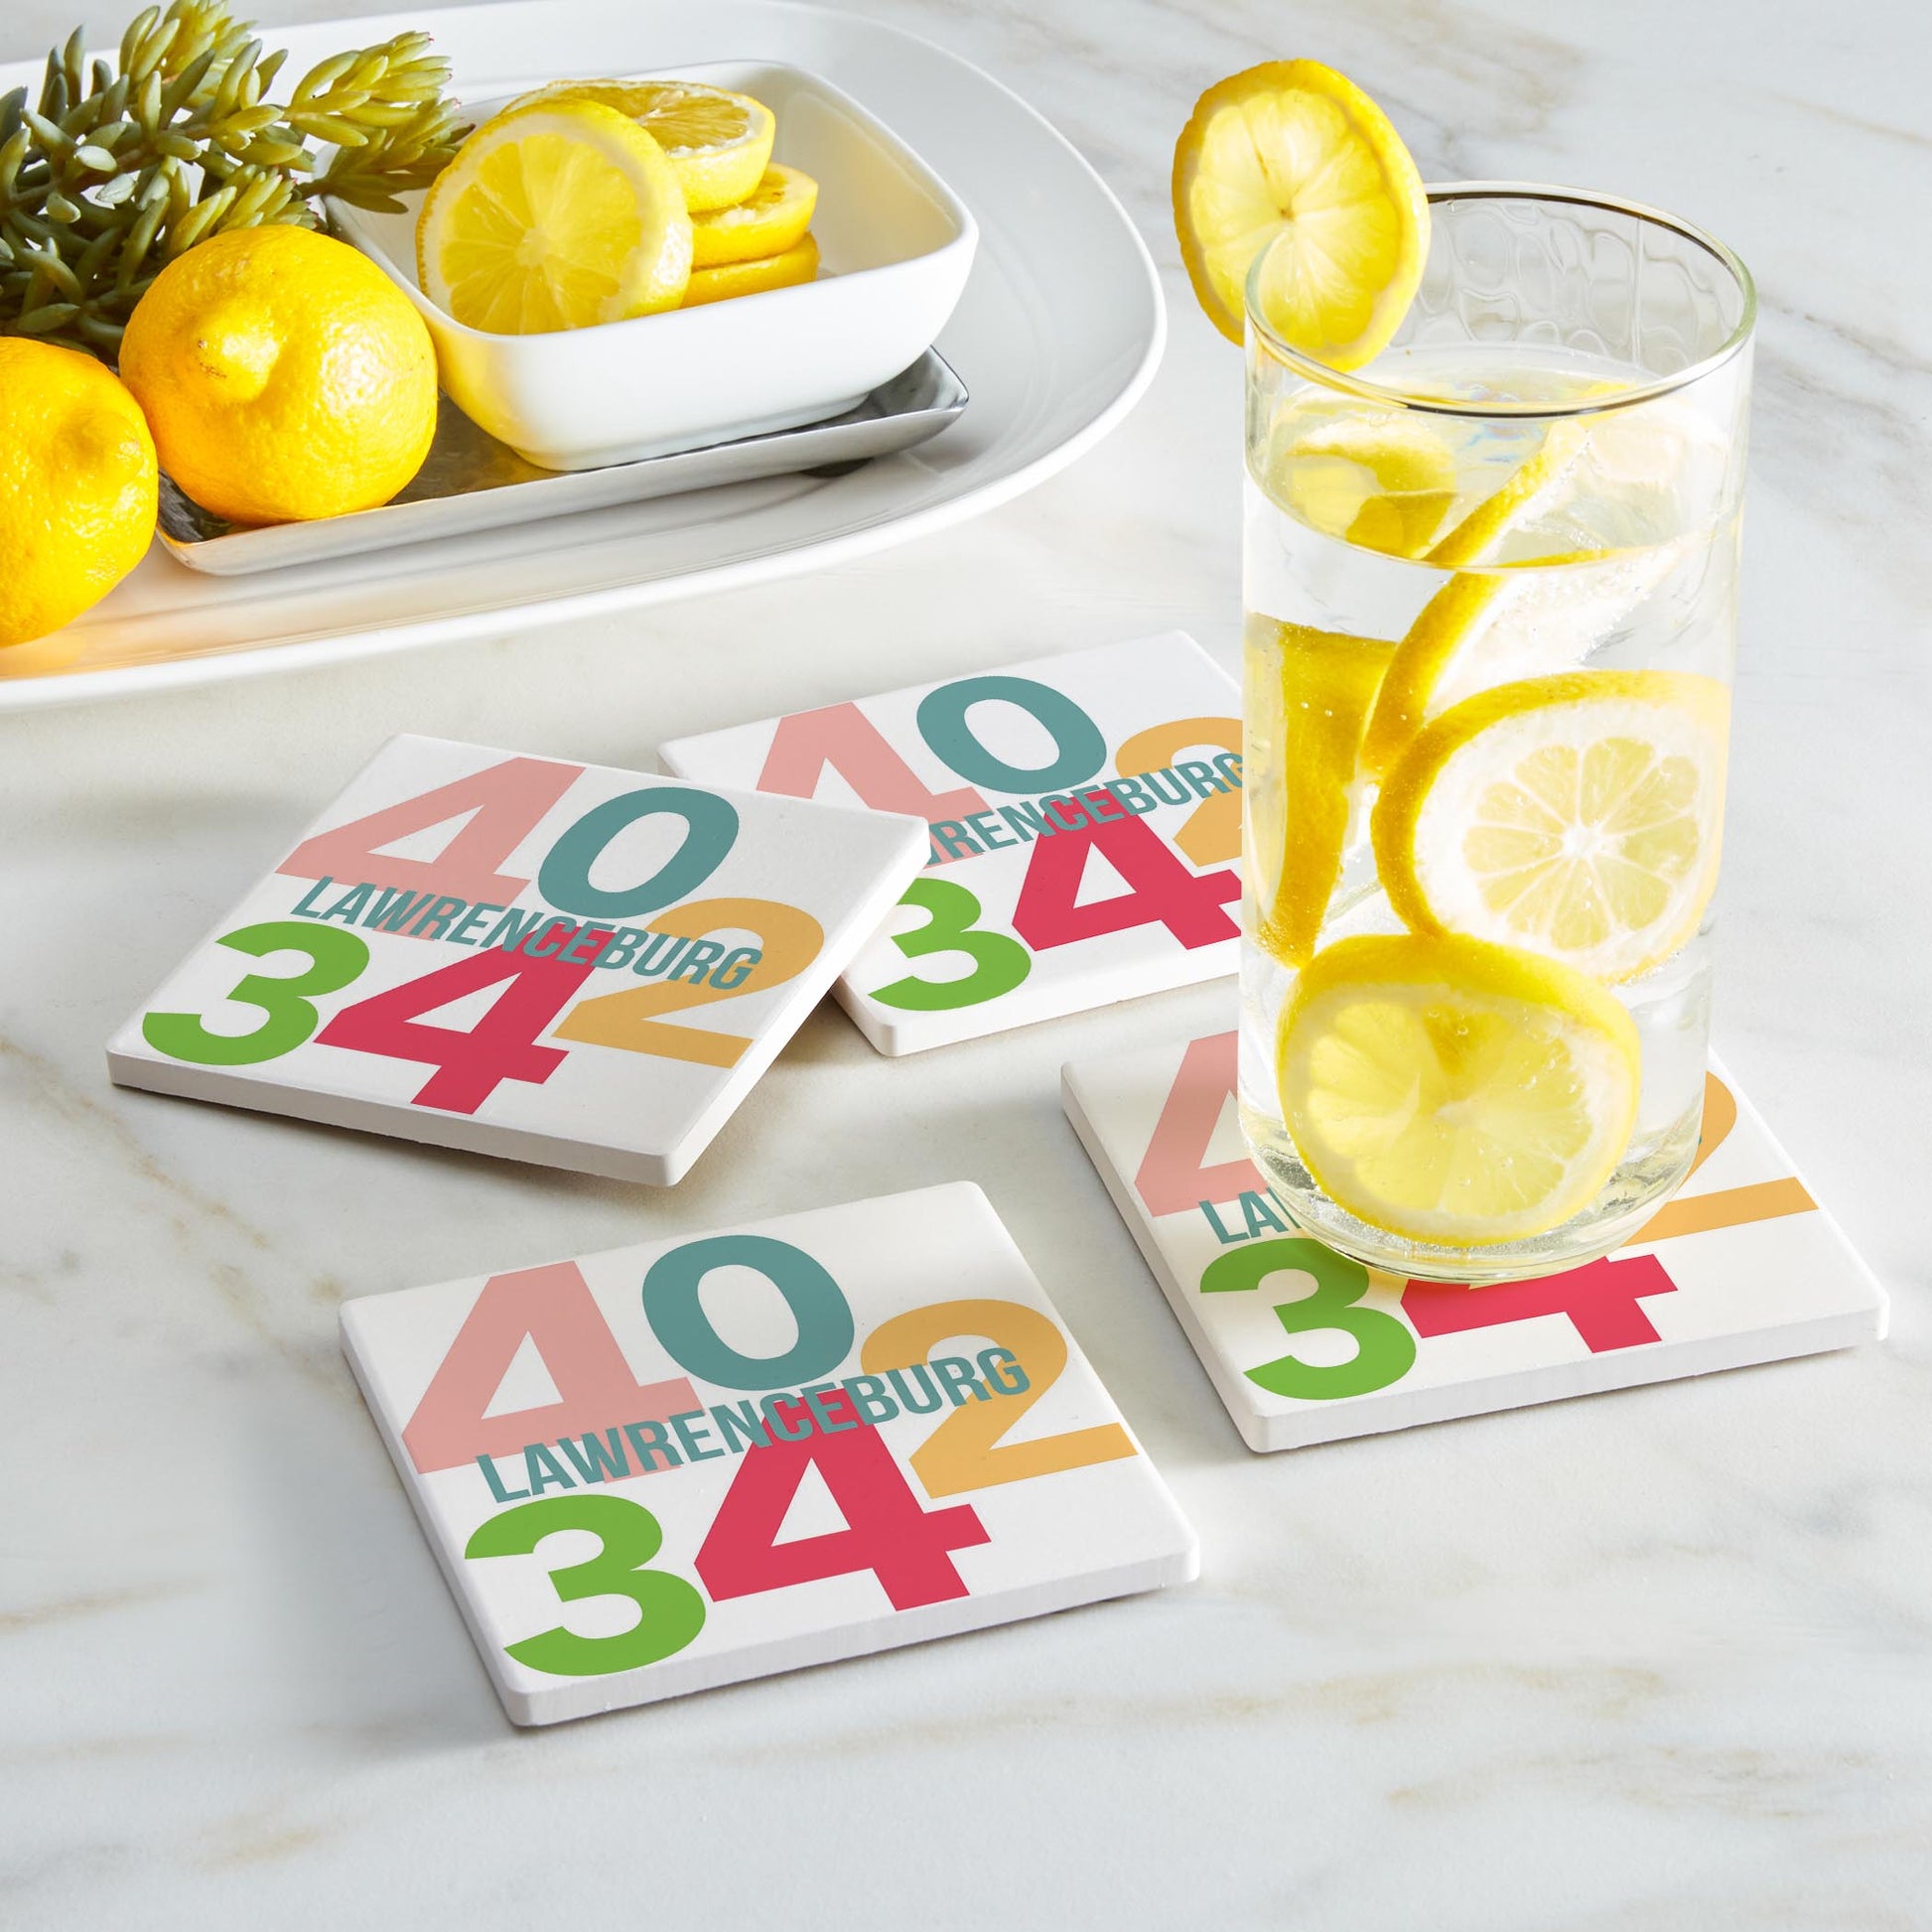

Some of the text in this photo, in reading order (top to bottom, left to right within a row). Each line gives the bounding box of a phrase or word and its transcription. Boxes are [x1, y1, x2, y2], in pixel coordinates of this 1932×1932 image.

[926, 753, 1243, 867] RENCEBURG
[291, 878, 760, 989] LAWRENCEBURG
[476, 1347, 1030, 1503] LAWRENCEBURG
